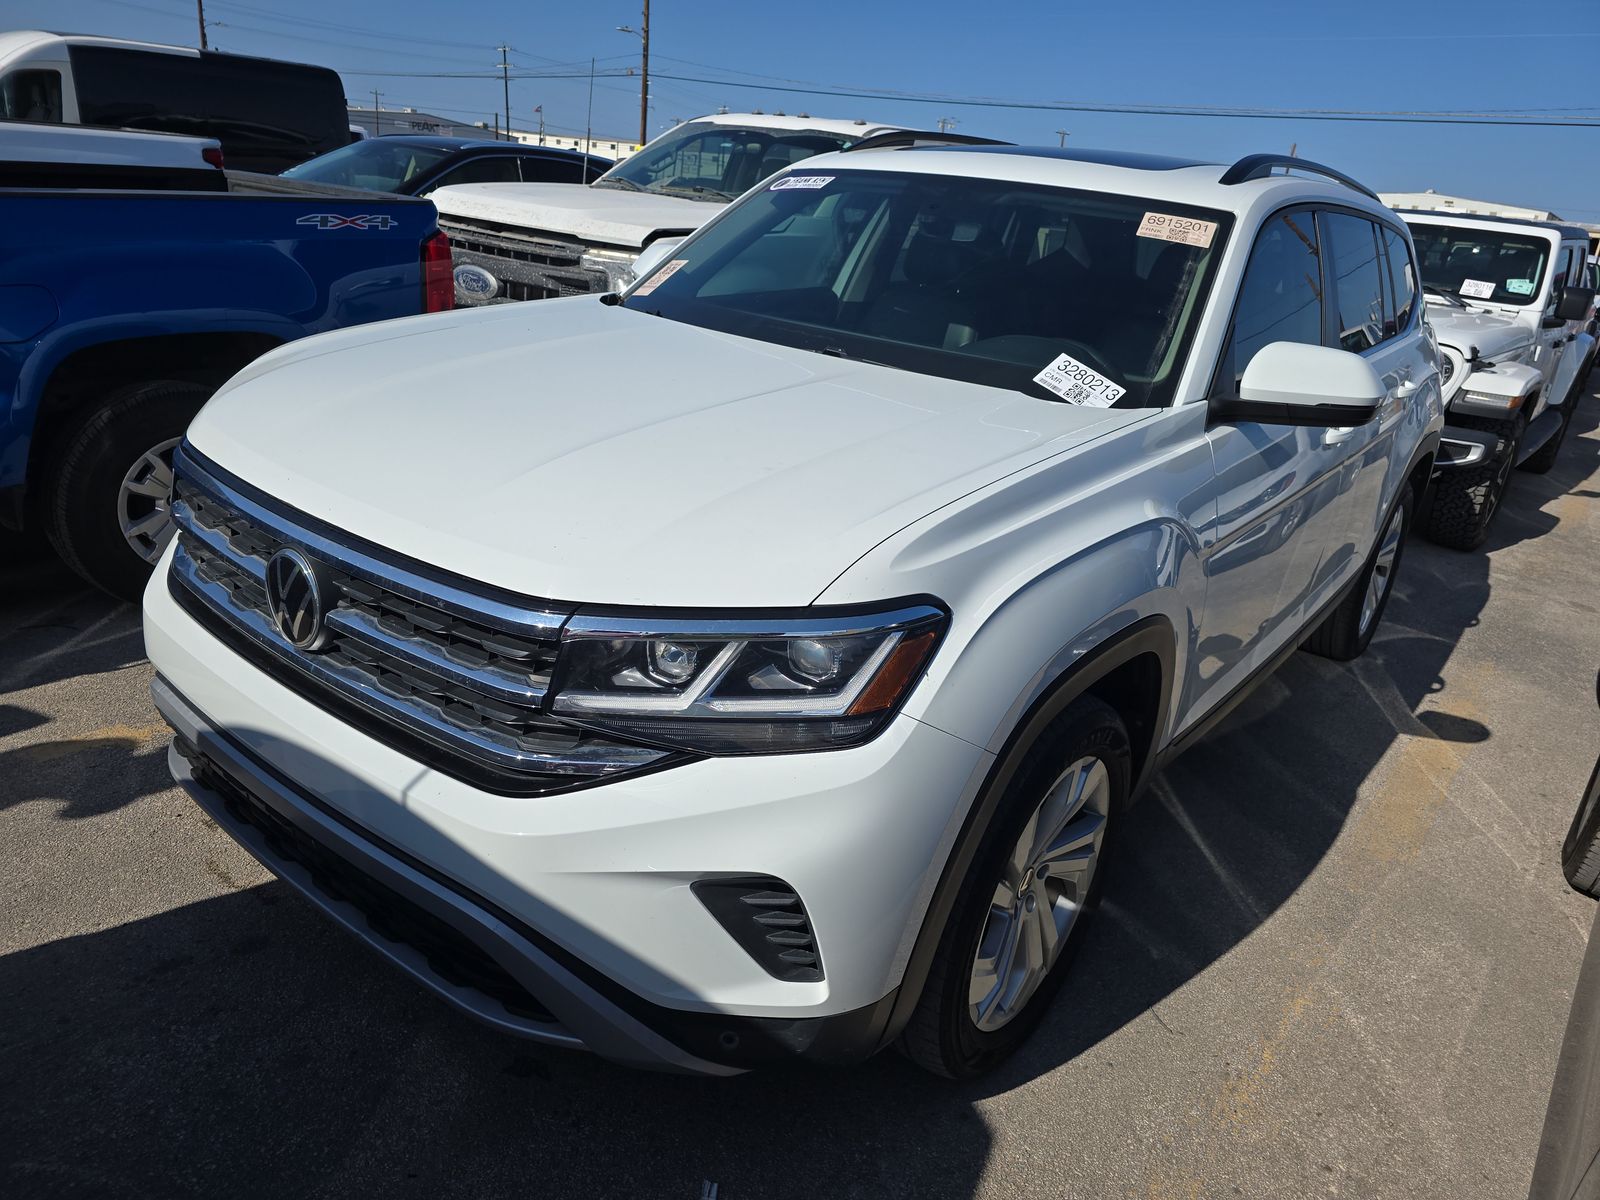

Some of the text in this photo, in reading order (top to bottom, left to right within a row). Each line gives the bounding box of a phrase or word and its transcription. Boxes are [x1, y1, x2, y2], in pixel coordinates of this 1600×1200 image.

[411, 121, 439, 133] PEAK
[1147, 215, 1209, 233] 6915201
[1044, 371, 1063, 385] CMR
[1057, 359, 1120, 401] 3280213
